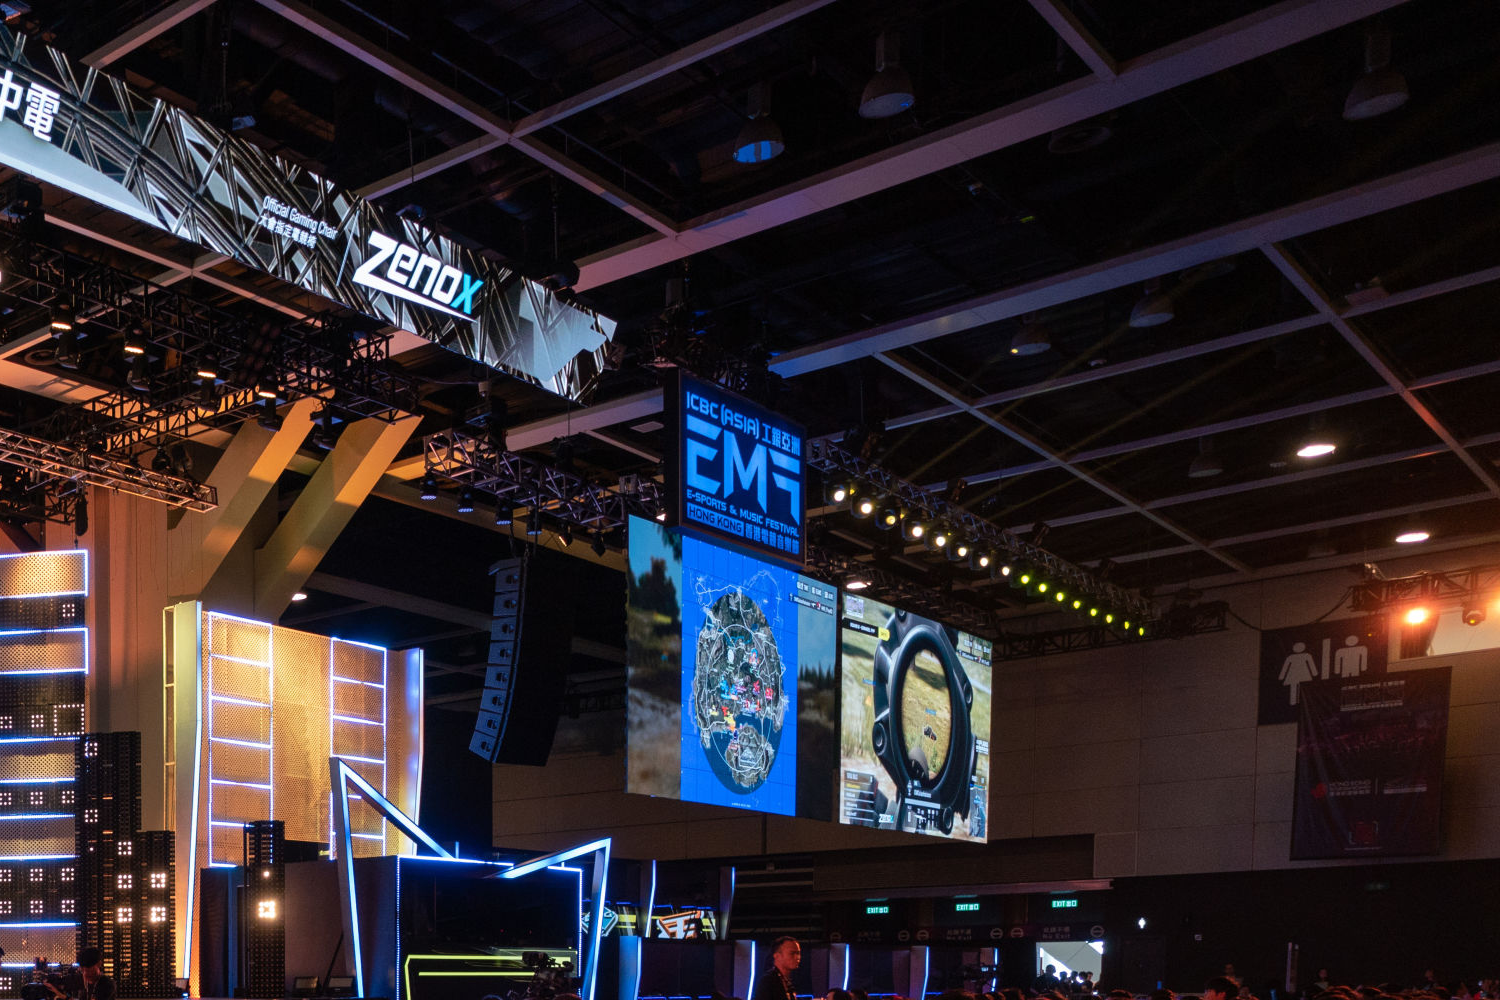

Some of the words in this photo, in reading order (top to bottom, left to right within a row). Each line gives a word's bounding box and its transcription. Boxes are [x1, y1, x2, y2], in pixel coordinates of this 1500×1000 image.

[263, 195, 290, 219] Official
[289, 207, 318, 233] Gaming
[318, 221, 339, 240] Chair
[686, 391, 718, 419] ICBC
[720, 404, 760, 439] (ASIA)
[686, 488, 727, 511] E-SPORTS
[729, 504, 737, 516] &
[739, 508, 763, 525] MUSIC
[765, 517, 800, 538] FESTIVAL
[689, 504, 715, 523] HONG
[717, 512, 742, 532] KONG
[1052, 900, 1066, 908] EXIT
